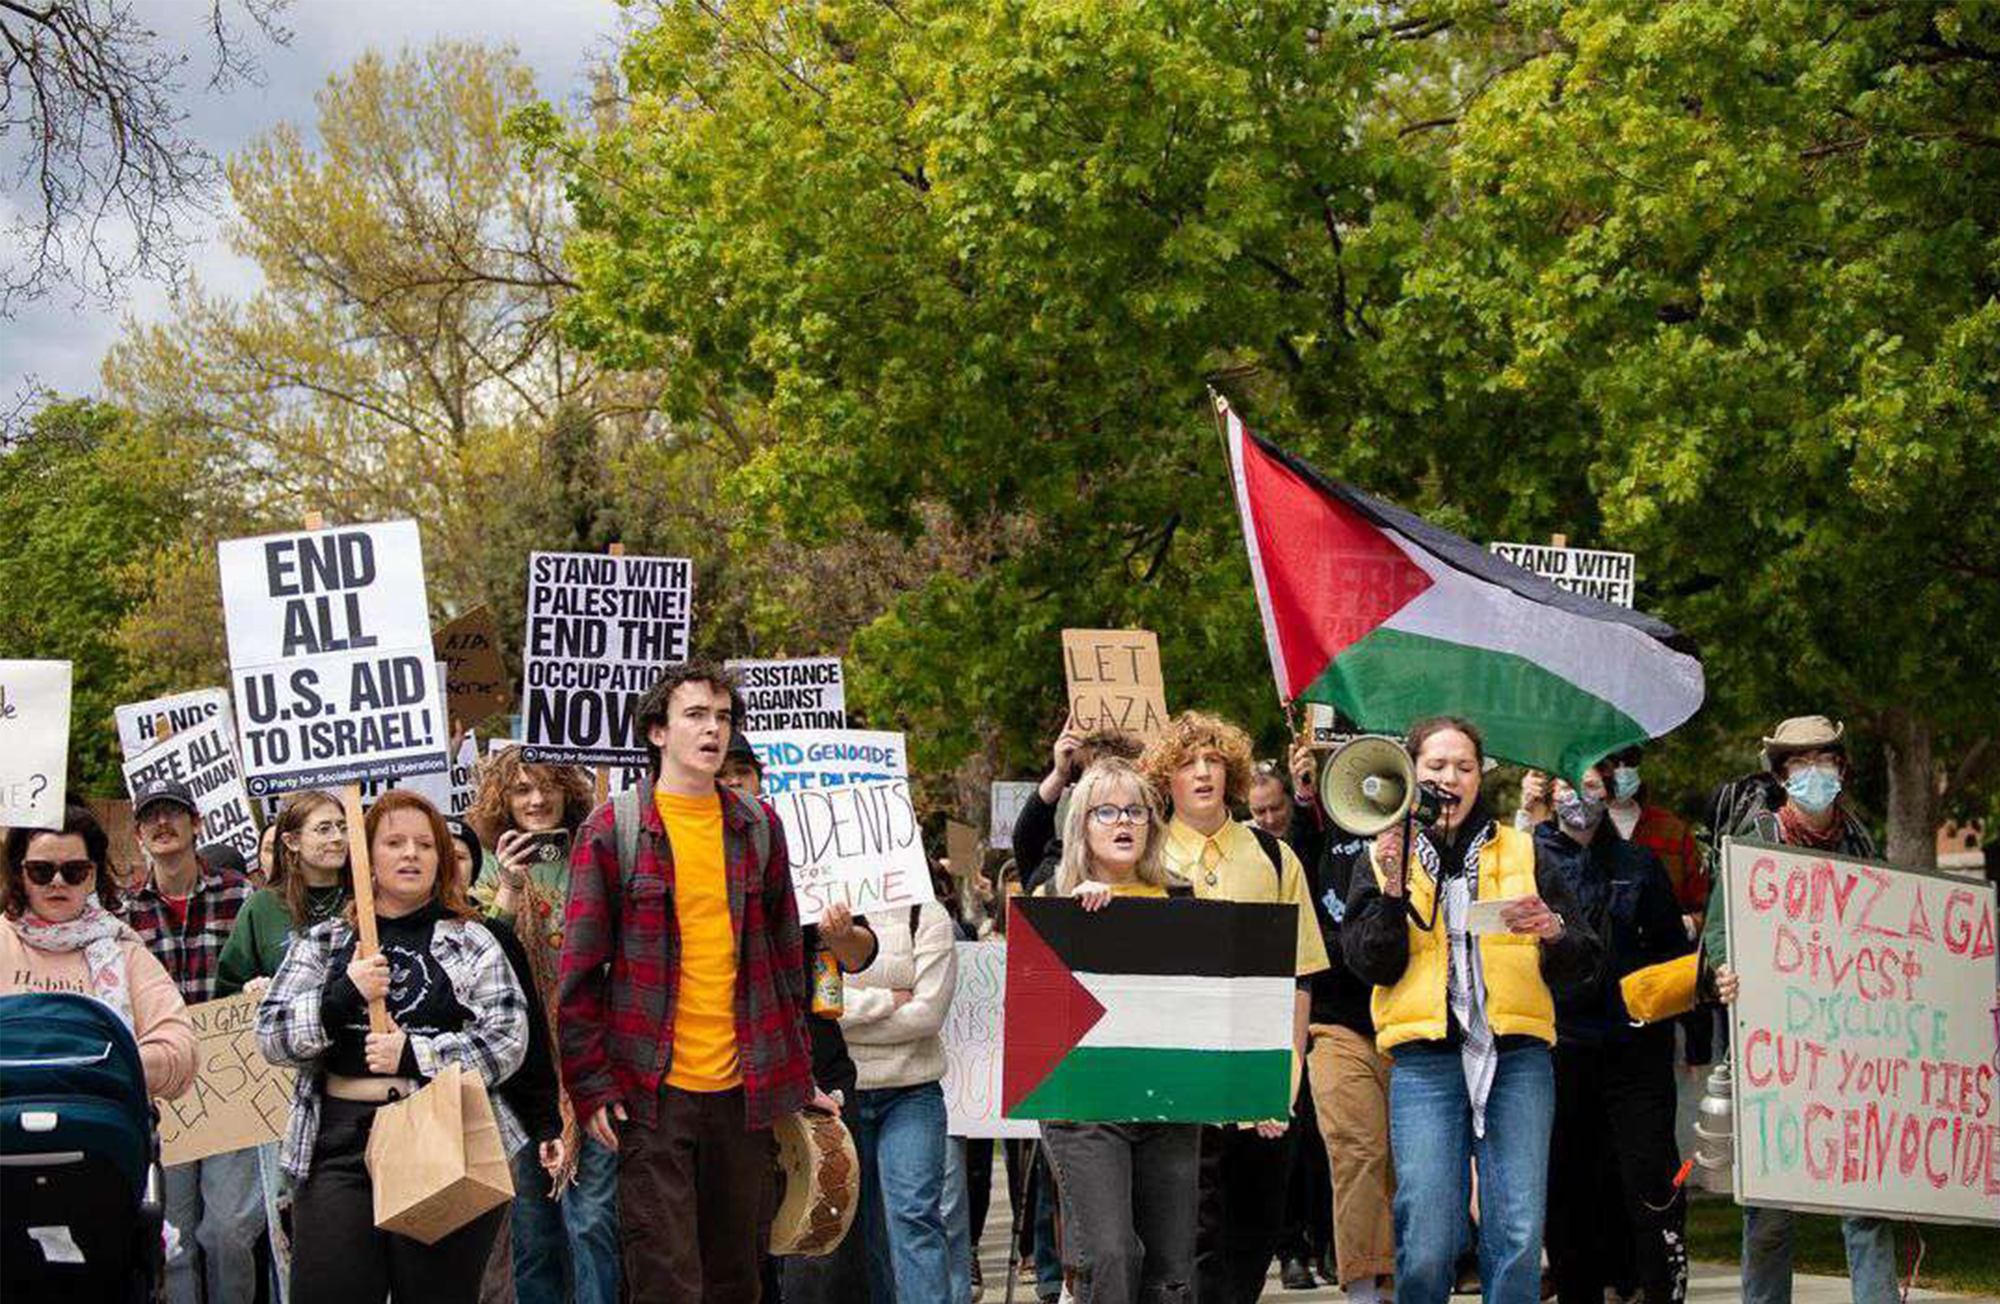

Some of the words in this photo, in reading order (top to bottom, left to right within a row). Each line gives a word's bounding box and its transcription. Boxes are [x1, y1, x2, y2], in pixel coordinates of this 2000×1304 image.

[264, 531, 376, 598] END
[534, 556, 617, 586] STAND
[625, 560, 687, 588] WITH
[1575, 553, 1630, 579] WITH
[533, 586, 686, 620] PALESTINE!
[282, 592, 378, 657] ALL
[531, 617, 607, 659] END
[618, 620, 686, 661] THE
[528, 660, 662, 691] OCCUPATIO
[1069, 645, 1145, 684] LET
[244, 668, 336, 724] U.S.
[350, 656, 426, 712] AID
[747, 688, 824, 711] AGAINST
[1073, 695, 1161, 735] GAZA
[188, 729, 230, 773] ALL
[246, 728, 291, 767] TO
[299, 709, 434, 761] ISRAEL!
[808, 743, 898, 768] GENOCIDE
[270, 777, 298, 790] Party
[299, 773, 315, 785] for
[370, 764, 390, 777] and
[391, 758, 446, 774] Liberation
[1750, 857, 1995, 960] GONZAGA
[214, 1002, 260, 1031] GAZ
[1745, 1029, 1828, 1091] CUT
[1920, 1062, 1994, 1118] TIES
[1744, 1090, 1799, 1178] TO
[1803, 1100, 2000, 1197] GENOCIDE
